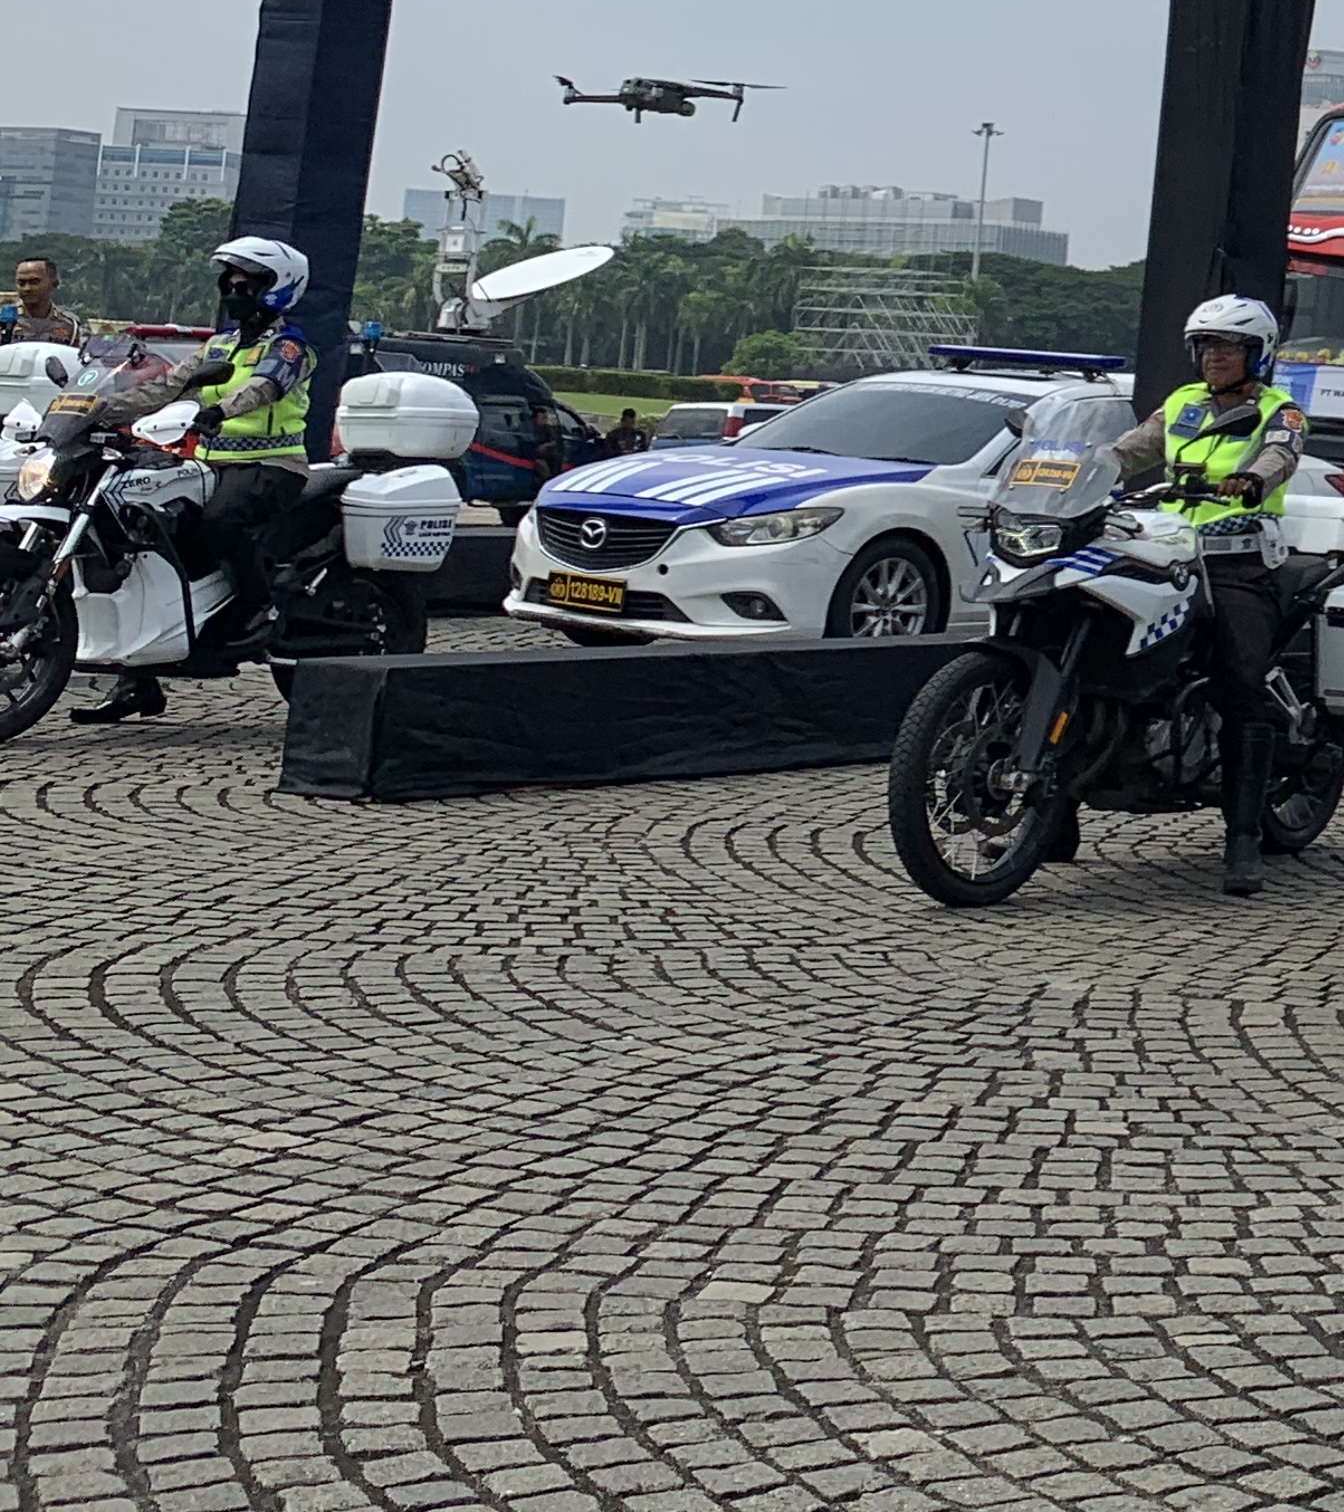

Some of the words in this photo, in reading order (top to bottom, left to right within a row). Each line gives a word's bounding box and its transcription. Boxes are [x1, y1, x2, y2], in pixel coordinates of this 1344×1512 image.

[420, 361, 465, 378] OMPAS
[1320, 389, 1332, 397] PT
[420, 519, 453, 530] POLISI
